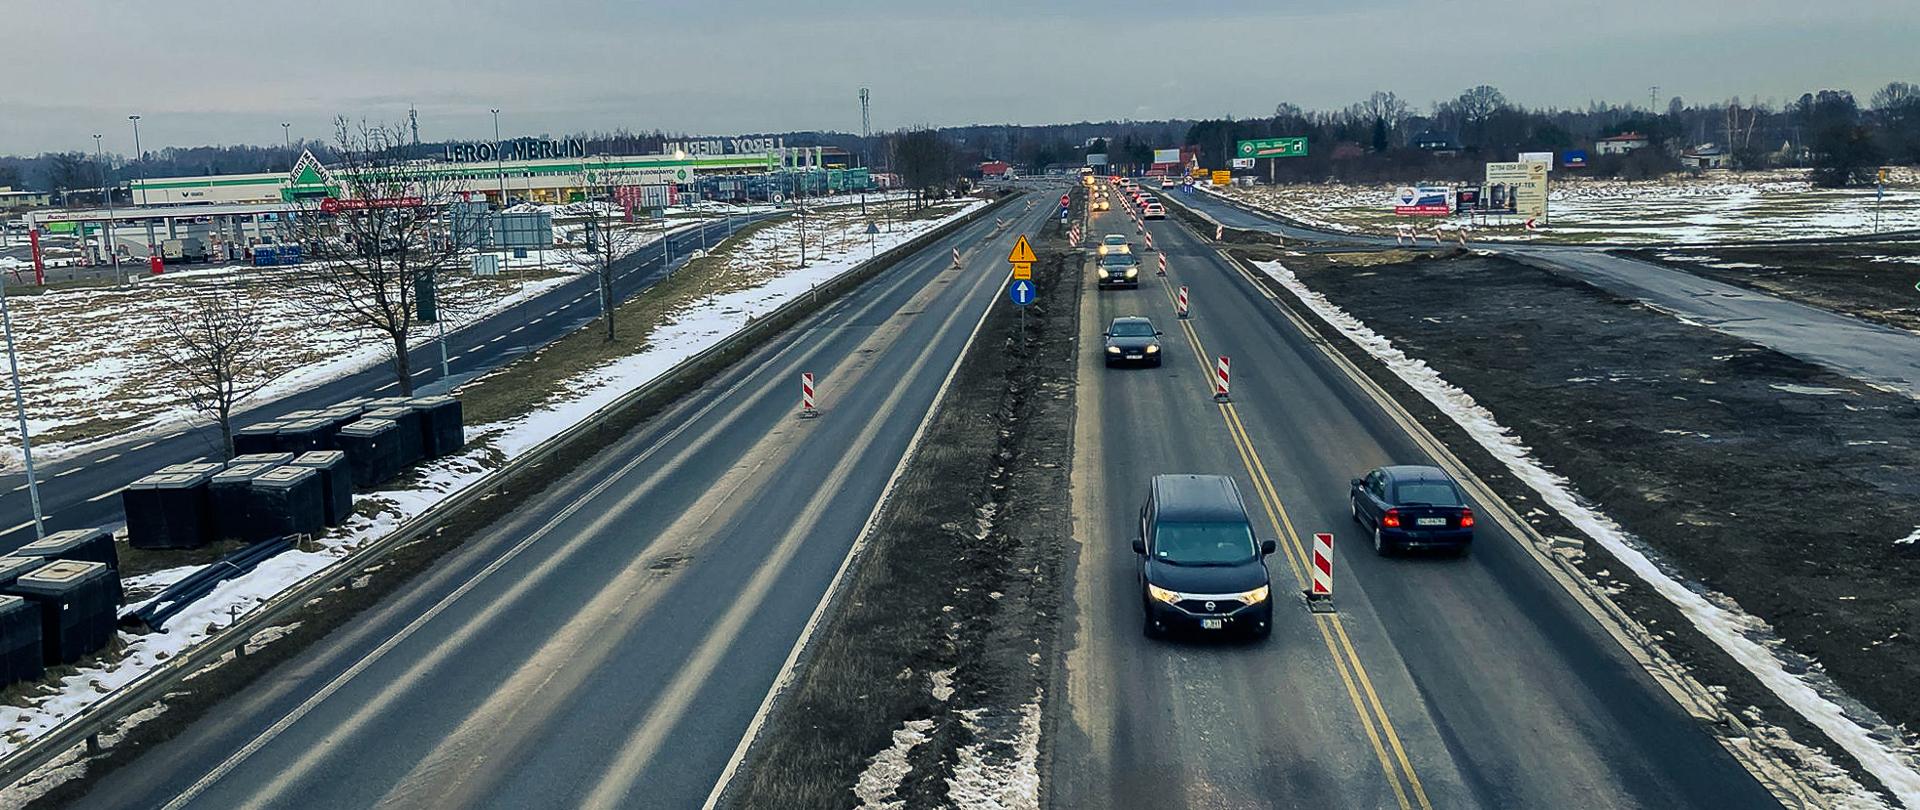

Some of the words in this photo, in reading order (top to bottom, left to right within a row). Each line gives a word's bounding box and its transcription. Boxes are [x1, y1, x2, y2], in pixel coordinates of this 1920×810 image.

[445, 142, 502, 162] LEROY
[511, 138, 586, 161] MERLIN
[290, 158, 306, 184] LEROY
[303, 152, 330, 183] MERLIN
